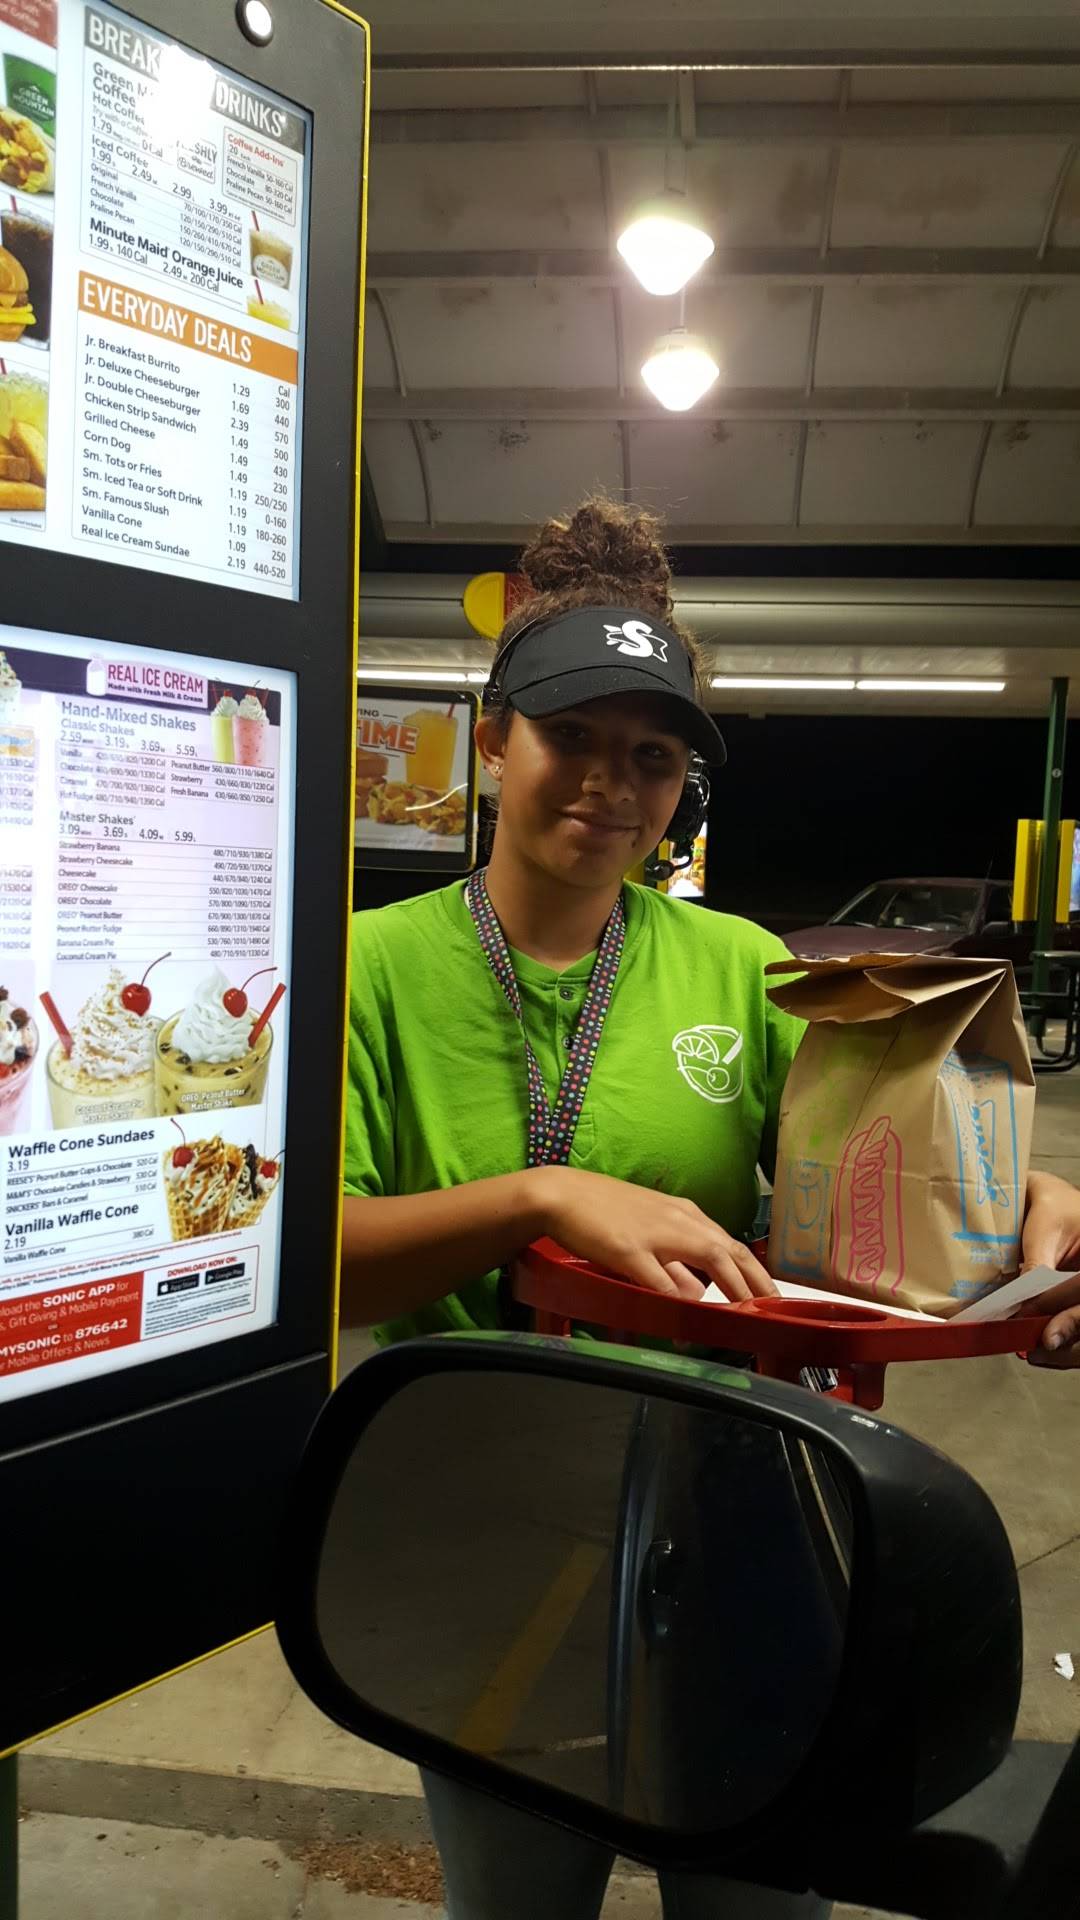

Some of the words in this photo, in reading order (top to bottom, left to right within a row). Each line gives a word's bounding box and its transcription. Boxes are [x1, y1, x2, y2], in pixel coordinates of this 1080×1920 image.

[90, 13, 162, 79] BREAK
[215, 81, 283, 138] DRINKS
[93, 62, 134, 92] Green
[93, 77, 136, 107] Coffee
[93, 92, 112, 109] Hot
[93, 116, 112, 134] 1.79
[92, 134, 114, 151] Iced
[116, 146, 150, 168] Coffee
[227, 134, 254, 154] Coffee
[91, 163, 118, 181] Original
[91, 147, 112, 164] 1.99
[132, 165, 152, 182] 2.49
[172, 182, 192, 199] 2.99
[209, 198, 228, 215] 3.99
[90, 188, 124, 208] Chocolate
[91, 176, 114, 192] French
[115, 185, 136, 201] Vanilla
[90, 201, 114, 217] Praline
[114, 210, 135, 225] Pecan
[90, 218, 136, 246] Minute
[137, 236, 170, 258] Maid
[172, 250, 216, 279] Orange
[216, 267, 243, 288] Juice
[90, 234, 109, 250] 1.99
[117, 244, 133, 259] 140
[134, 251, 148, 265] Cal
[162, 262, 183, 279] 2.49
[190, 272, 206, 287] 200
[206, 281, 220, 293] Cal
[83, 276, 190, 340] EVERYDAY
[193, 317, 253, 364] DEALS
[86, 334, 97, 346] Jr.
[98, 338, 146, 363] Breakfast
[148, 354, 181, 374] Burrito
[232, 383, 250, 397] 1.29
[275, 397, 290, 411] 300
[85, 353, 96, 366] Jr.
[98, 357, 133, 376] Deluxe
[134, 368, 201, 398] Cheeseburger
[232, 400, 250, 415] 1.69
[274, 414, 290, 428] 440
[278, 385, 291, 398] Cal
[84, 372, 95, 384] Jr.
[97, 376, 134, 395] Double
[135, 388, 201, 416] Cheeseburger
[230, 417, 249, 432] 2.39
[274, 431, 289, 445] 570
[84, 392, 125, 412] Chicken
[126, 403, 151, 420] Strip
[152, 411, 197, 433] Sandwich
[231, 435, 249, 449] 1.49
[273, 448, 289, 462] 500
[84, 410, 119, 428] Grilled
[119, 421, 156, 439] Cheese
[230, 453, 248, 467] 1.49
[273, 465, 288, 479] 430
[83, 429, 109, 446] Corn
[110, 437, 131, 453] Dog
[230, 470, 248, 484] 1.49
[273, 482, 288, 496] 230
[83, 448, 102, 462] Sm.
[105, 453, 126, 468] Tots
[127, 462, 138, 471] or
[139, 463, 162, 478] Fries
[229, 487, 247, 501] 1.19
[254, 494, 288, 513] 250/250
[82, 467, 102, 480] Sm.
[104, 472, 125, 487] Iced
[127, 477, 144, 491] Tea
[145, 484, 156, 493] or
[157, 486, 177, 500] Soft
[178, 491, 203, 507] Drink
[229, 505, 247, 519] 1.19
[265, 513, 287, 529] 0-160
[82, 486, 102, 500] Sm.
[103, 491, 142, 510] Famous
[143, 501, 170, 516] Slush
[228, 522, 246, 536] 1.19
[255, 529, 287, 546] 180-260
[81, 504, 116, 522] Vanilla
[117, 513, 143, 528] Cone
[228, 539, 246, 553] 1.09
[271, 550, 286, 563] 250
[81, 524, 104, 538] Real
[105, 529, 120, 541] Ice
[121, 533, 153, 549] Cream
[154, 540, 190, 557] Sundae
[227, 555, 246, 570] 2.19
[253, 562, 286, 580] 440-520
[108, 664, 139, 684] REAL
[141, 667, 160, 687] ICE
[163, 671, 203, 695] CREAM
[108, 683, 125, 692] Made
[127, 686, 142, 694] with
[143, 688, 161, 697] Fresh
[163, 691, 176, 699] Milk
[183, 694, 203, 703] Cream
[60, 719, 97, 734] Classic
[99, 722, 135, 737] Shakes
[61, 701, 148, 725] Hand-Mixed
[151, 712, 197, 732] Shakes
[358, 707, 380, 721] ING
[60, 731, 82, 743] 2.59
[105, 735, 126, 749] 3.19
[141, 740, 160, 752] 3.69
[176, 744, 195, 756] 5.59
[358, 718, 420, 755] IME
[171, 760, 192, 769] Peanut
[193, 763, 211, 772] Butter
[171, 773, 203, 785] Strawberry
[171, 787, 187, 796] Fresh
[188, 788, 209, 798] Banana
[59, 823, 80, 836] 3.09
[103, 825, 124, 838] 3.69
[139, 828, 159, 840] 4.09
[174, 830, 194, 842] 5.99
[60, 811, 97, 823] Master
[98, 813, 135, 826] Shakes
[9, 1141, 56, 1158] Waffle
[59, 1137, 94, 1152] Cone
[97, 1130, 155, 1147] Sundaes
[8, 1159, 29, 1173] 3.19
[5, 1217, 55, 1237] Vanilla
[58, 1209, 102, 1227] Waffle
[105, 1204, 140, 1218] Cone
[4, 1236, 26, 1250] 2.19
[168, 1262, 207, 1277] DOWNLOAD
[207, 1259, 226, 1269] NOW
[9, 1314, 28, 1329] Gift
[28, 1308, 59, 1326] Giving
[59, 1307, 69, 1318] &
[69, 1301, 99, 1316] Mobile
[100, 1291, 140, 1310] Payment
[25, 1300, 41, 1311] the
[42, 1290, 87, 1308] SONIC
[88, 1283, 116, 1298] APP
[117, 1281, 130, 1291] for
[63, 1332, 74, 1343] to
[74, 1318, 129, 1341] 876642
[8, 1353, 41, 1369] Mobile
[41, 1346, 75, 1360] Offers
[75, 1342, 83, 1352] &
[84, 1336, 111, 1350] News
